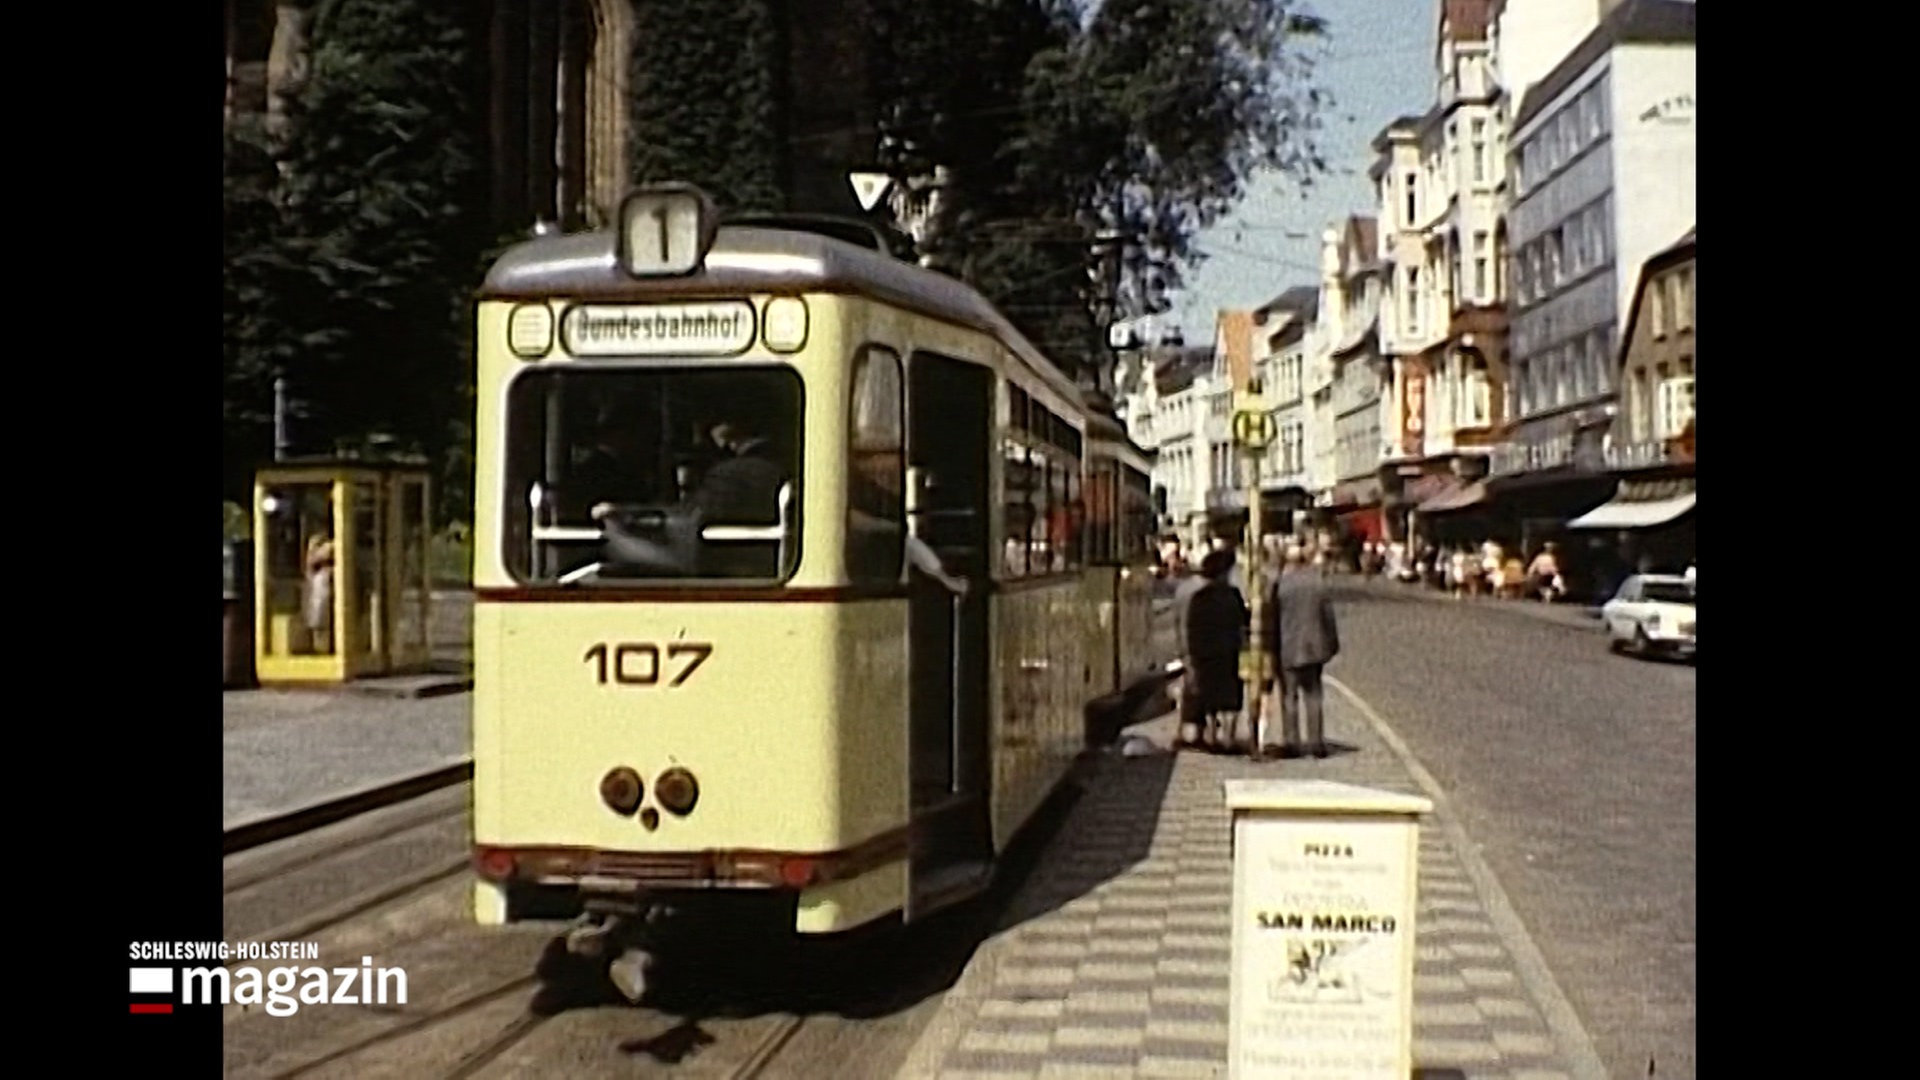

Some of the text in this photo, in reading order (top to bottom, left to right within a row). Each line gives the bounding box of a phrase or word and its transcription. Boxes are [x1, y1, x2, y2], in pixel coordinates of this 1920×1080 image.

[651, 206, 669, 263] 1
[577, 308, 740, 342] Bundesbahnhof
[1244, 412, 1266, 438] H
[583, 642, 714, 688] 107
[1303, 843, 1354, 858] PIZZA
[1256, 911, 1397, 934] SAN MARCO
